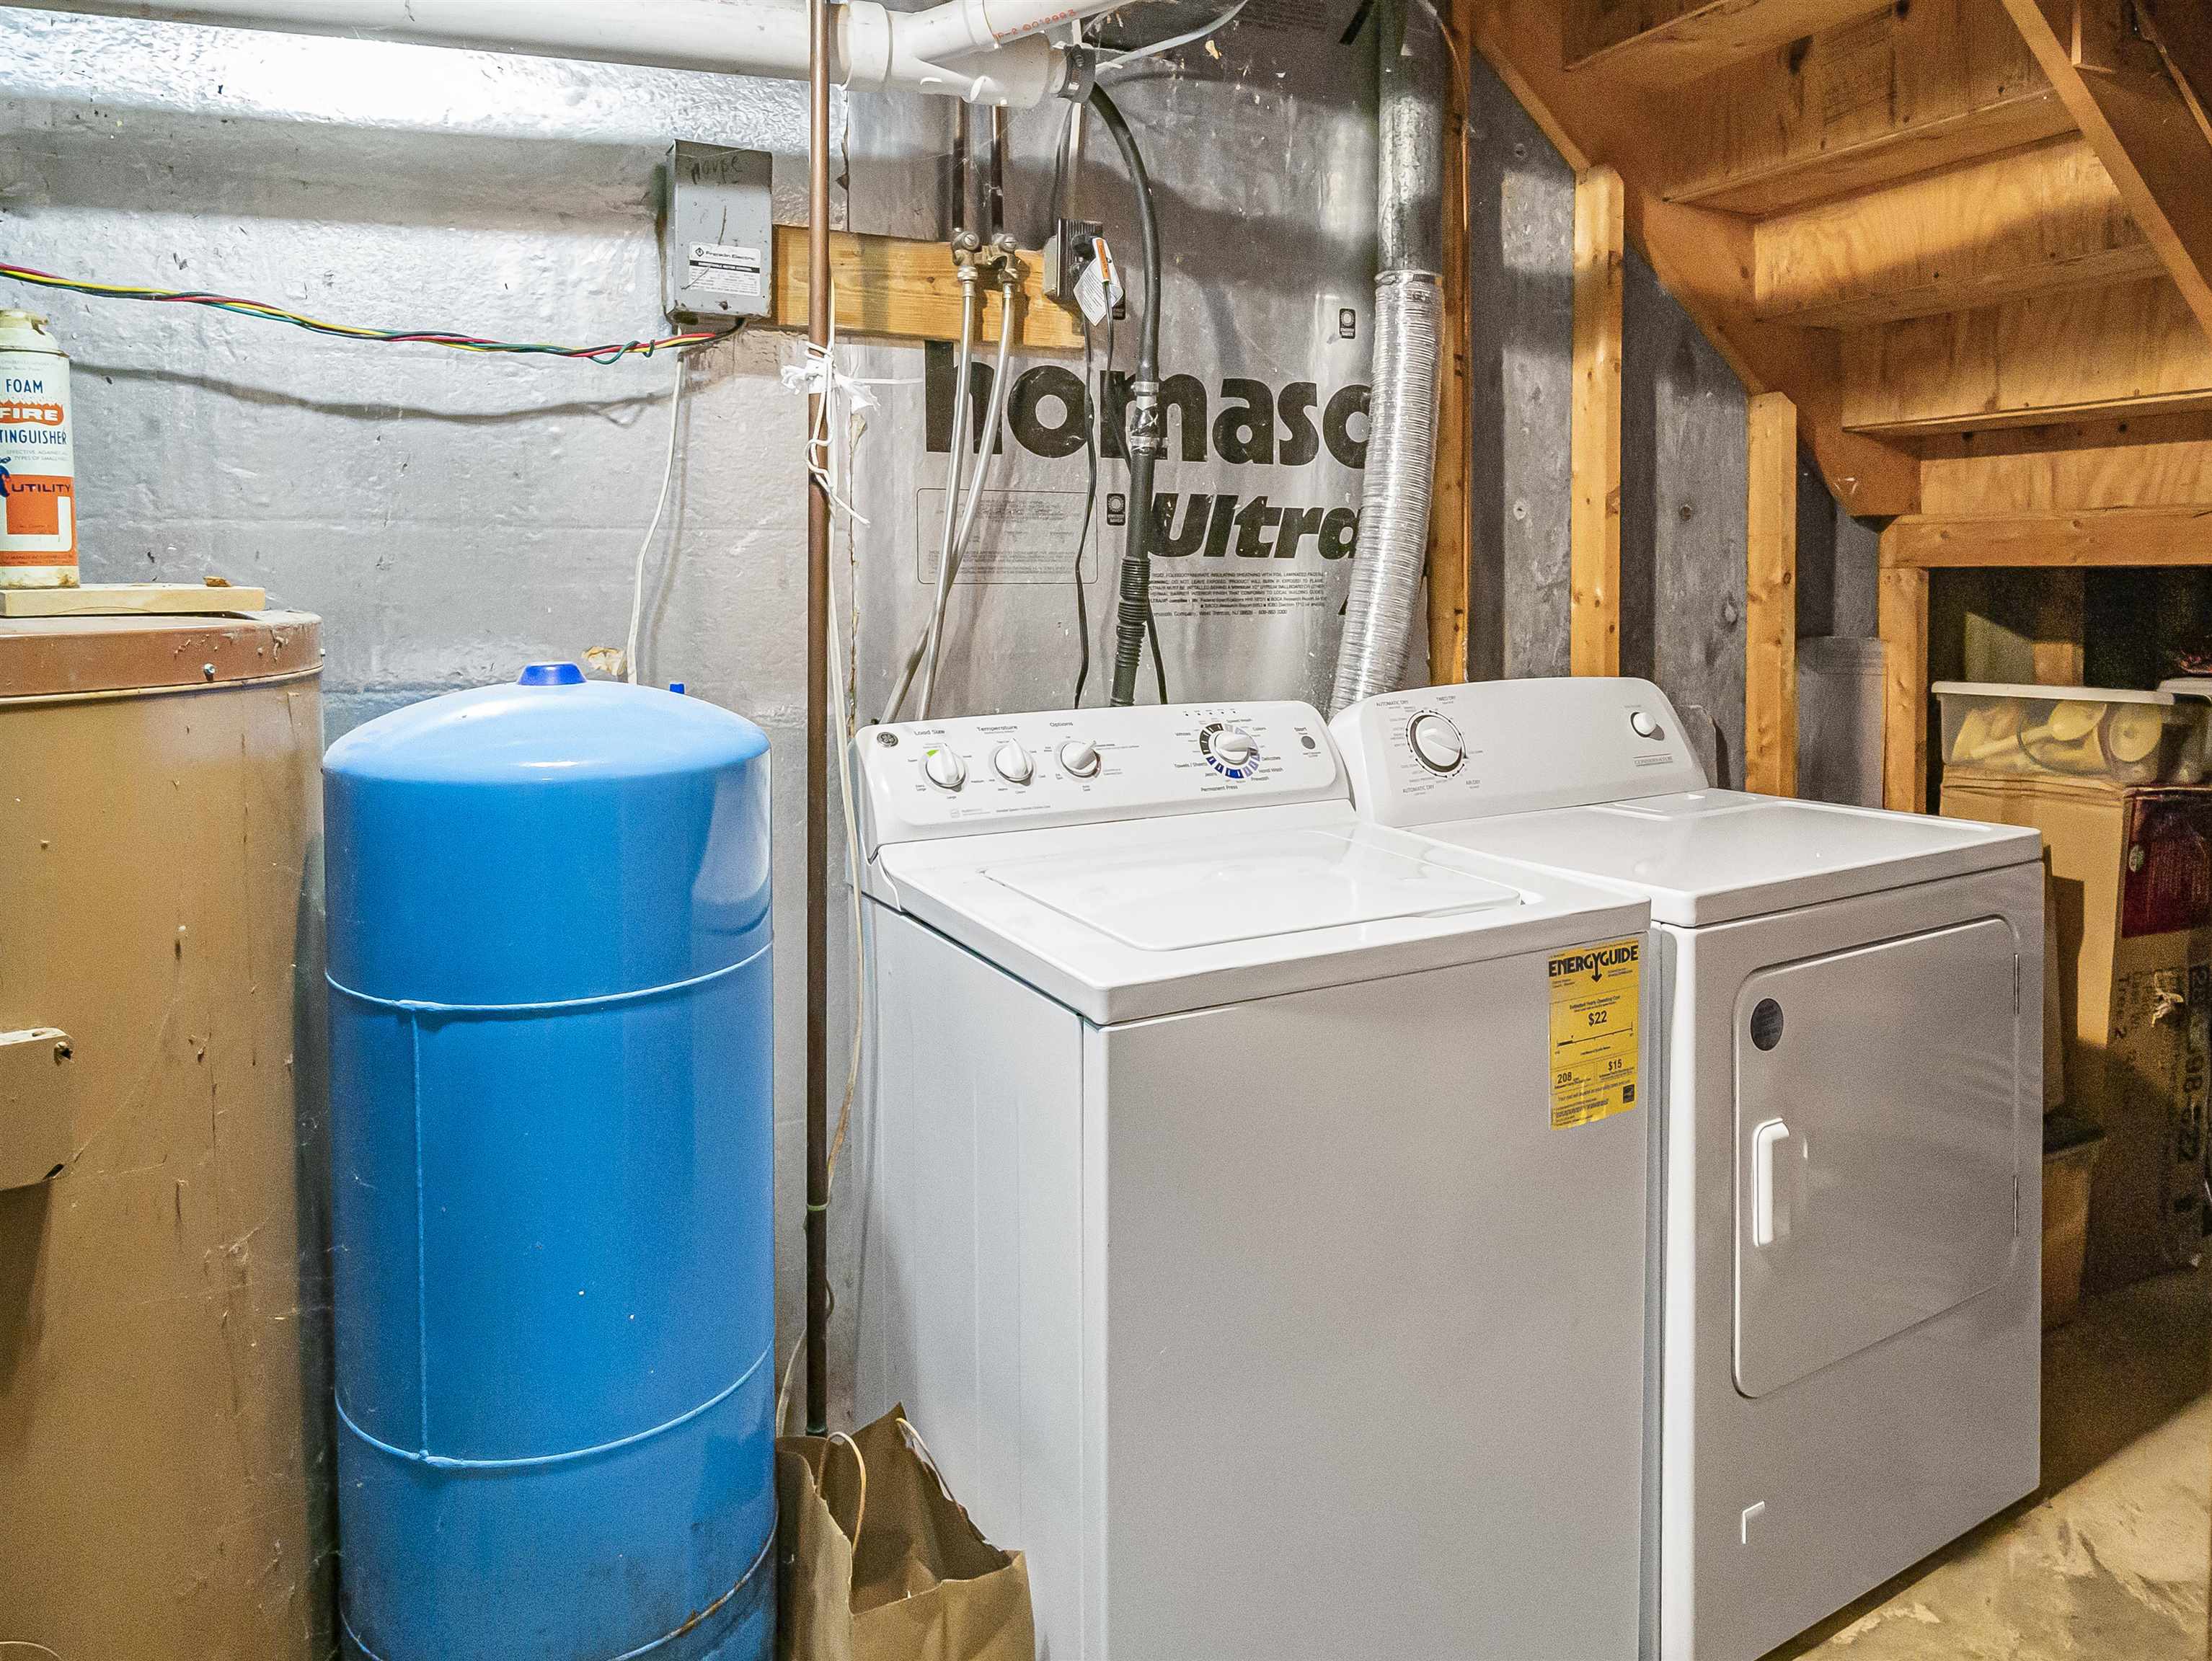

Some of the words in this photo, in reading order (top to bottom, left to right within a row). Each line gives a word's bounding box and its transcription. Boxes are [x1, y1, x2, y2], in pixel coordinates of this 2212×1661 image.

[6, 378, 43, 394] FOAM
[0, 407, 58, 422] FIRE
[11, 483, 71, 493] UTILITY
[1549, 944, 1639, 978] ENERGYGUIDE
[1588, 1010, 1608, 1027] $22
[1608, 1058, 1623, 1072] $15
[1557, 1071, 1572, 1084] 208
